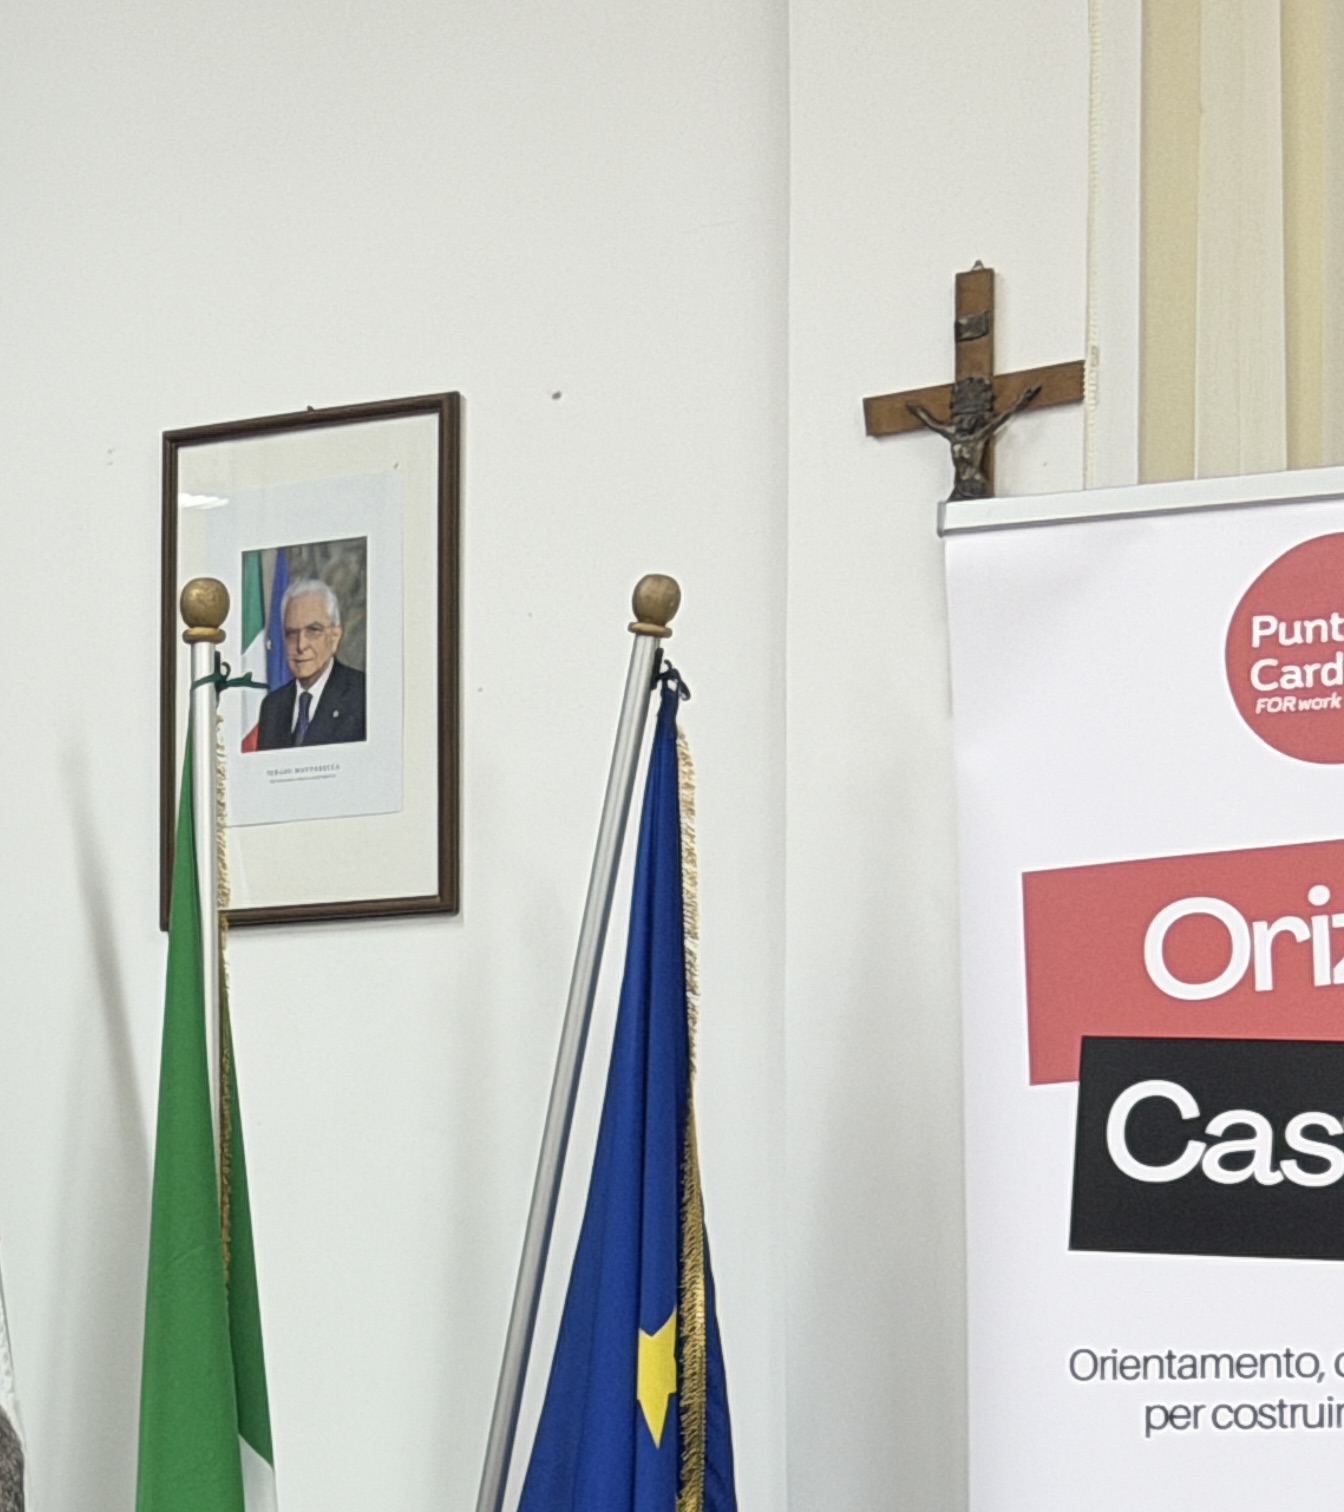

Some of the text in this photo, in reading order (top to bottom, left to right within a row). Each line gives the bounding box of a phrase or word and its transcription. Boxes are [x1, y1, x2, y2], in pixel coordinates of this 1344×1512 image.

[1252, 612, 1344, 648] Punt
[1250, 651, 1344, 691] Card
[1255, 692, 1342, 714] FOR work
[1144, 885, 1344, 1000] Ori
[1106, 1079, 1344, 1187] Cas
[1069, 1348, 1325, 1383] Orientamento,
[1145, 1396, 1344, 1438] per costruir
